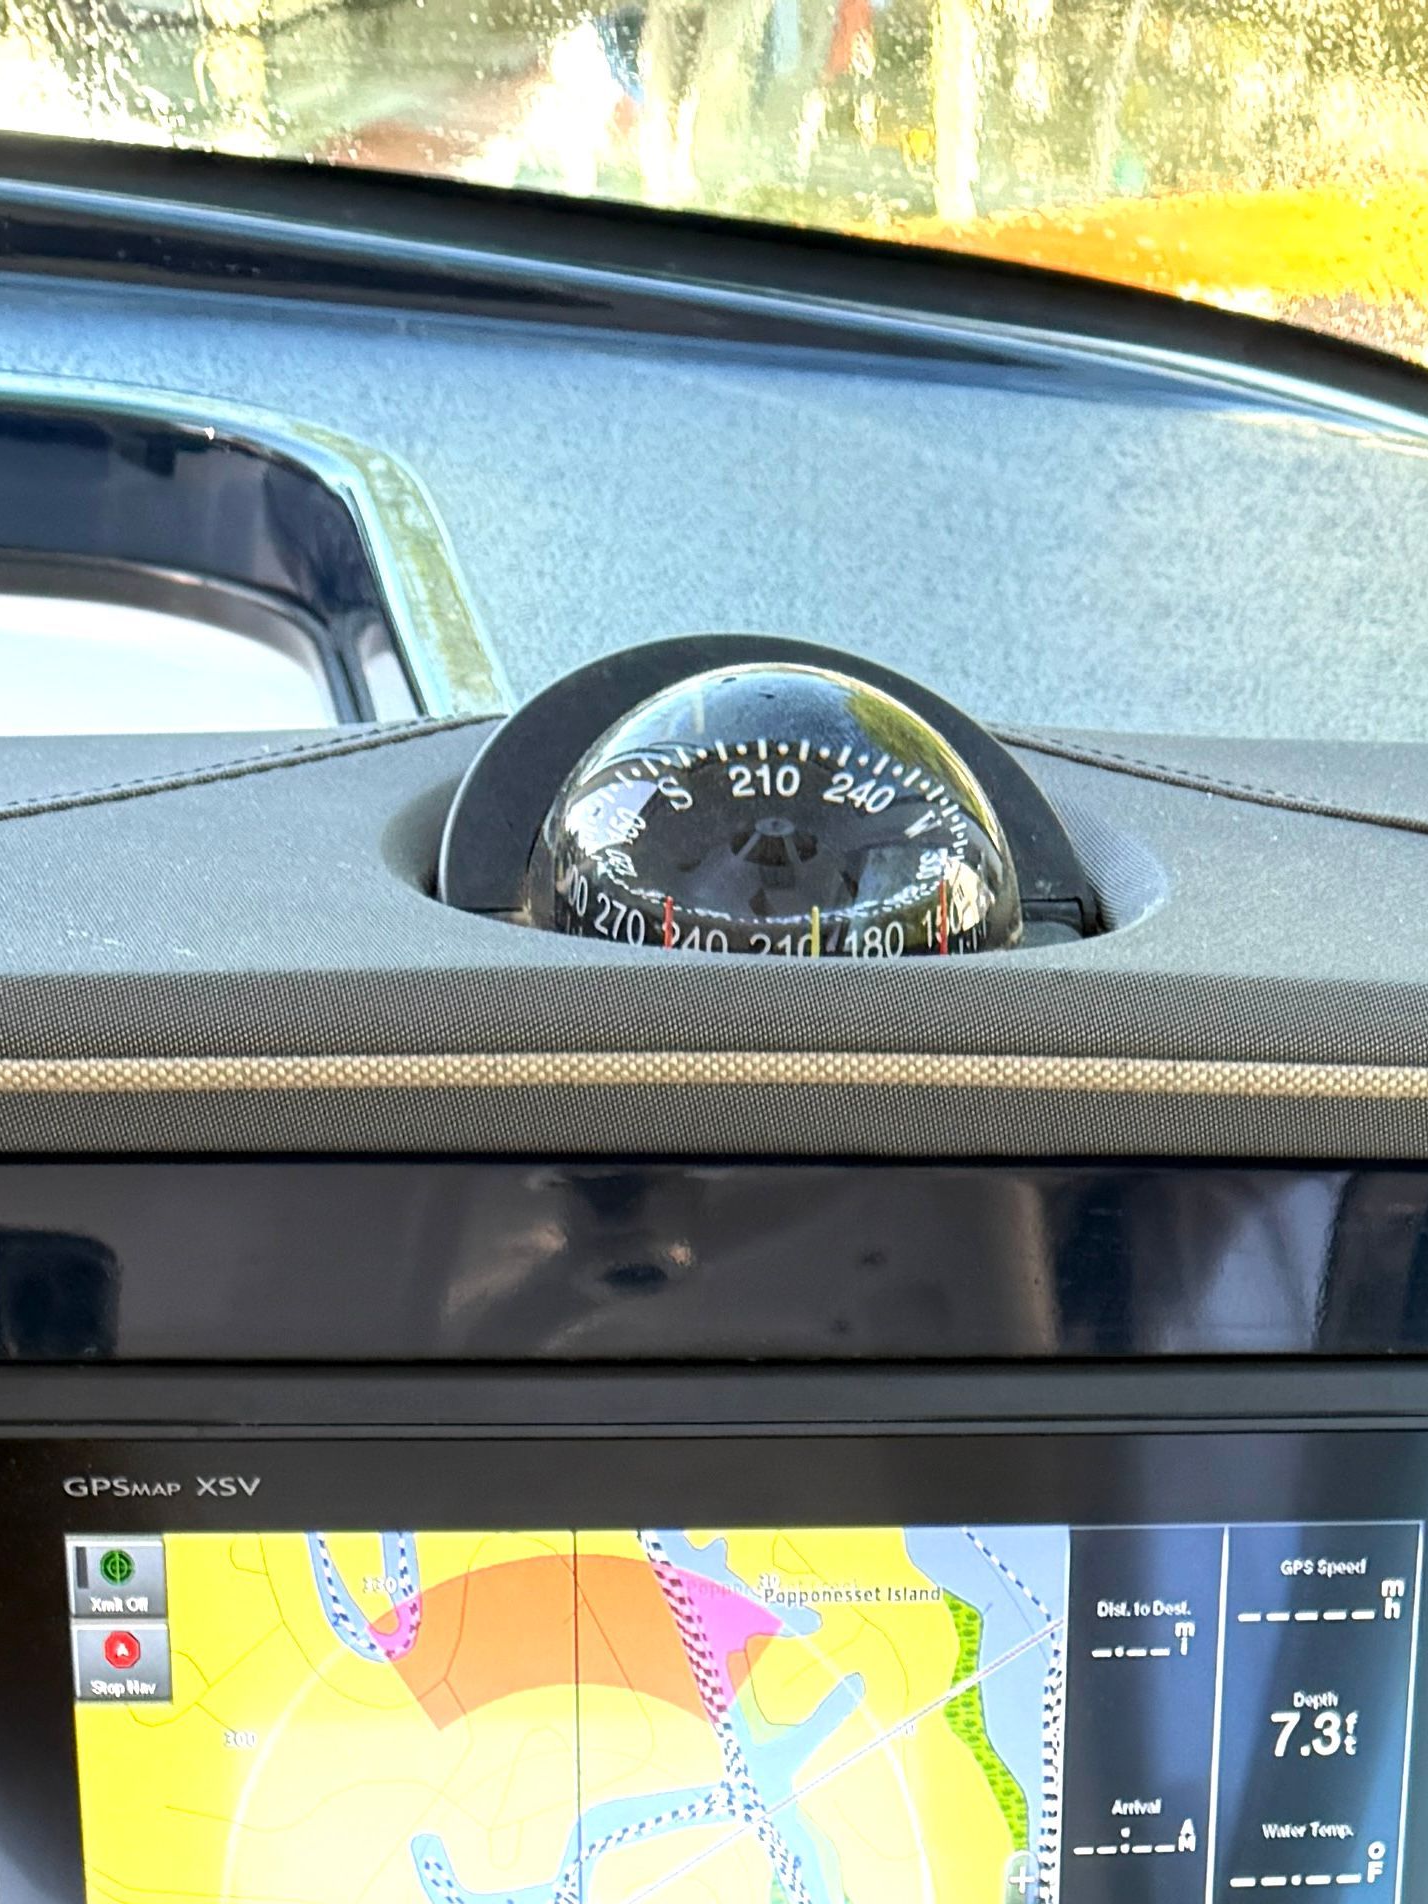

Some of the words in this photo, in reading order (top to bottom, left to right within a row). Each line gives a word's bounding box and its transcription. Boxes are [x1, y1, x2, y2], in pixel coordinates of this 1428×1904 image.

[728, 763, 801, 798] 210
[656, 775, 694, 812] S
[822, 772, 896, 815] 240
[594, 892, 646, 947] 270
[844, 920, 904, 958] 180
[62, 1475, 182, 1498] GPSMAP
[195, 1475, 262, 1497] XSV
[1280, 1558, 1314, 1577] GPS
[1317, 1557, 1367, 1579] Speed
[763, 1586, 881, 1607] Popponesset
[886, 1586, 942, 1601] Island
[1133, 1600, 1151, 1617] to
[90, 1679, 126, 1698] Stop
[1292, 1690, 1339, 1710] Depth
[1270, 1710, 1342, 1758] 7.3
[1111, 1798, 1163, 1817] Arrival
[1261, 1822, 1307, 1840] Water
[1309, 1820, 1355, 1840] Temp.
